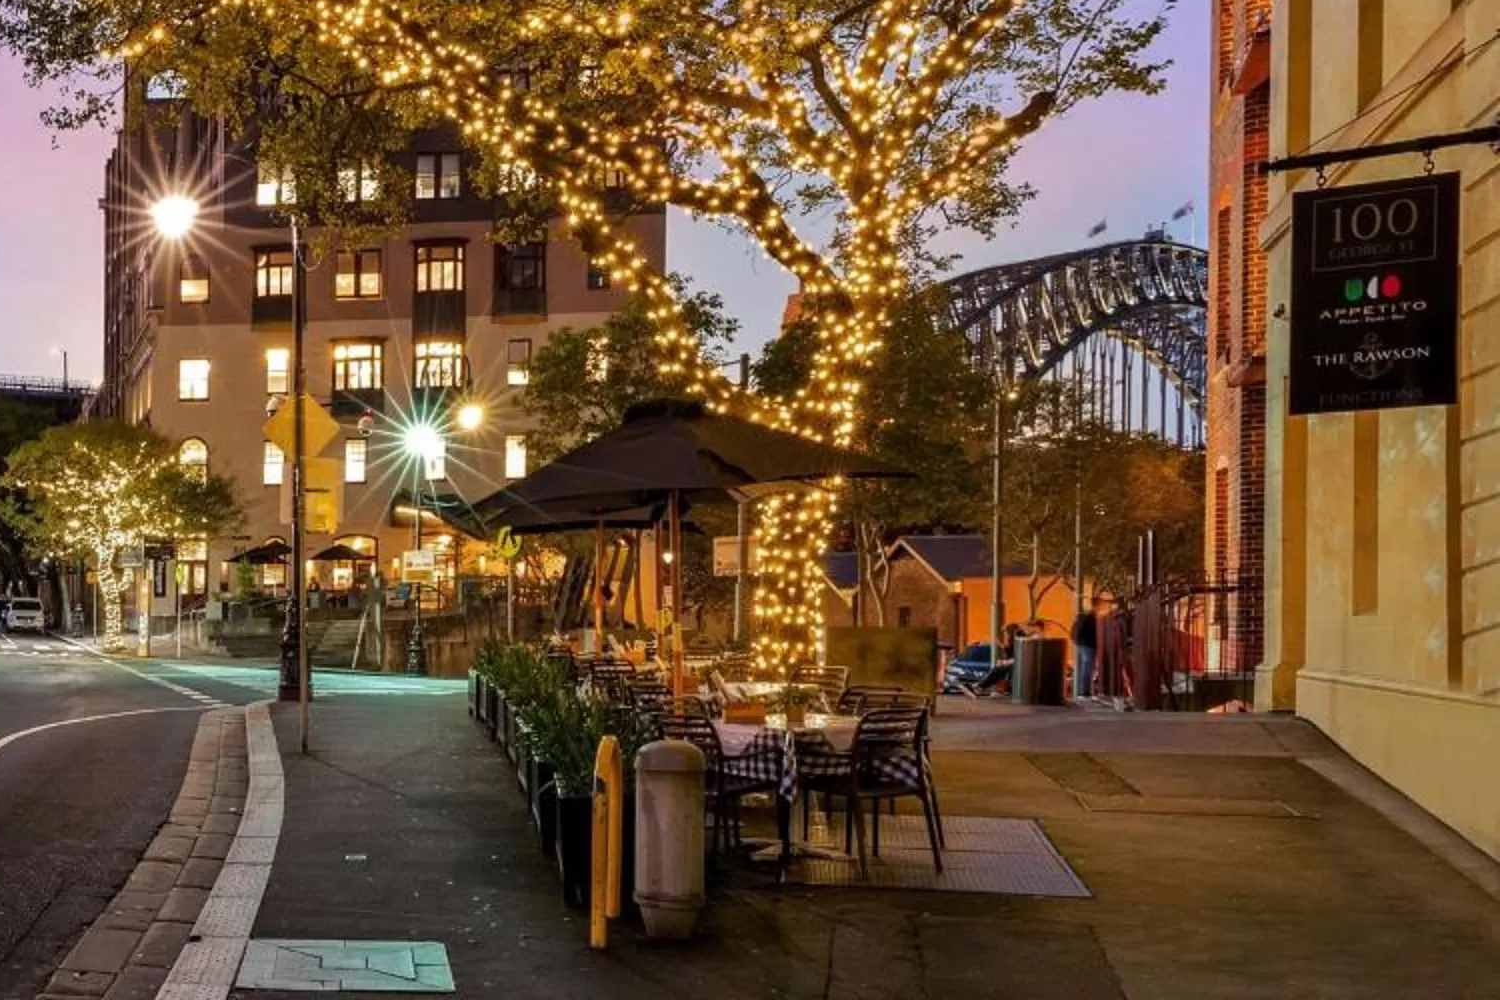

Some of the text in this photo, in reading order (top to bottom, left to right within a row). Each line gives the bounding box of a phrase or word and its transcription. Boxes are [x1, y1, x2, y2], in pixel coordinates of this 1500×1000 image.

[1331, 198, 1418, 243] 100
[1319, 300, 1427, 319] APPETITO
[1313, 346, 1431, 367] THE RAWSON
